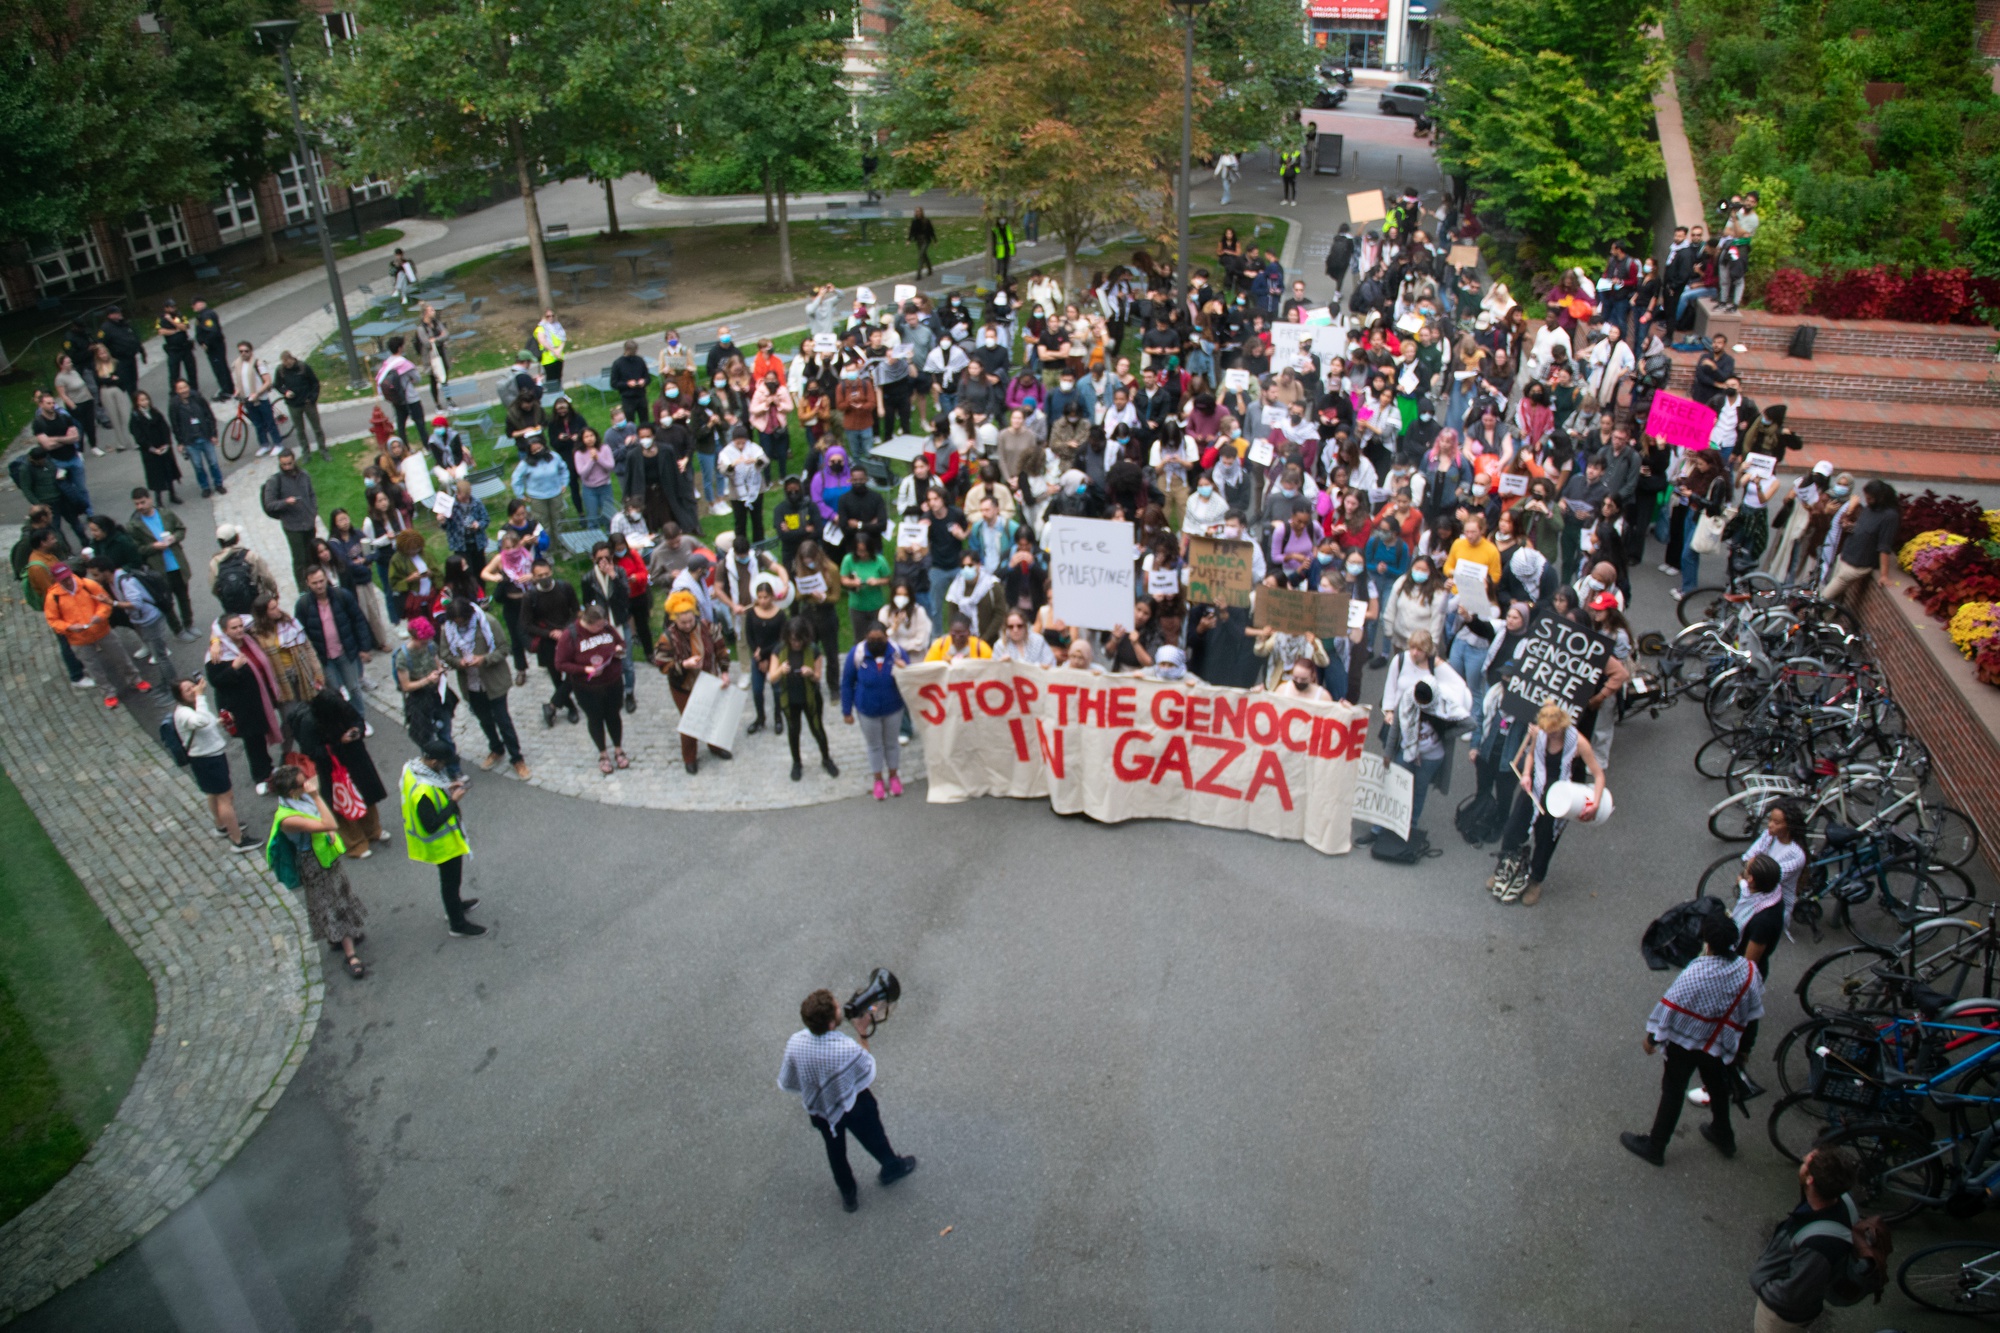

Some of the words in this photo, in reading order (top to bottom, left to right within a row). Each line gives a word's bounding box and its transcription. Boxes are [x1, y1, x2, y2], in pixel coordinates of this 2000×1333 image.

[1058, 528, 1111, 555] Free
[1057, 564, 1132, 588] PALESTINE!
[1190, 566, 1243, 582] JUSTICE
[1197, 555, 1246, 570] WADEA
[1535, 618, 1605, 660] STOP
[1520, 656, 1583, 699] FREE
[1526, 638, 1602, 685] GENOCIDE
[918, 676, 1038, 726] STOP
[1048, 684, 1137, 729] THE
[1151, 689, 1369, 762] GENOCIDE
[1009, 718, 1065, 779] IN
[1112, 730, 1294, 812] GAZA
[1359, 757, 1391, 784] STOP
